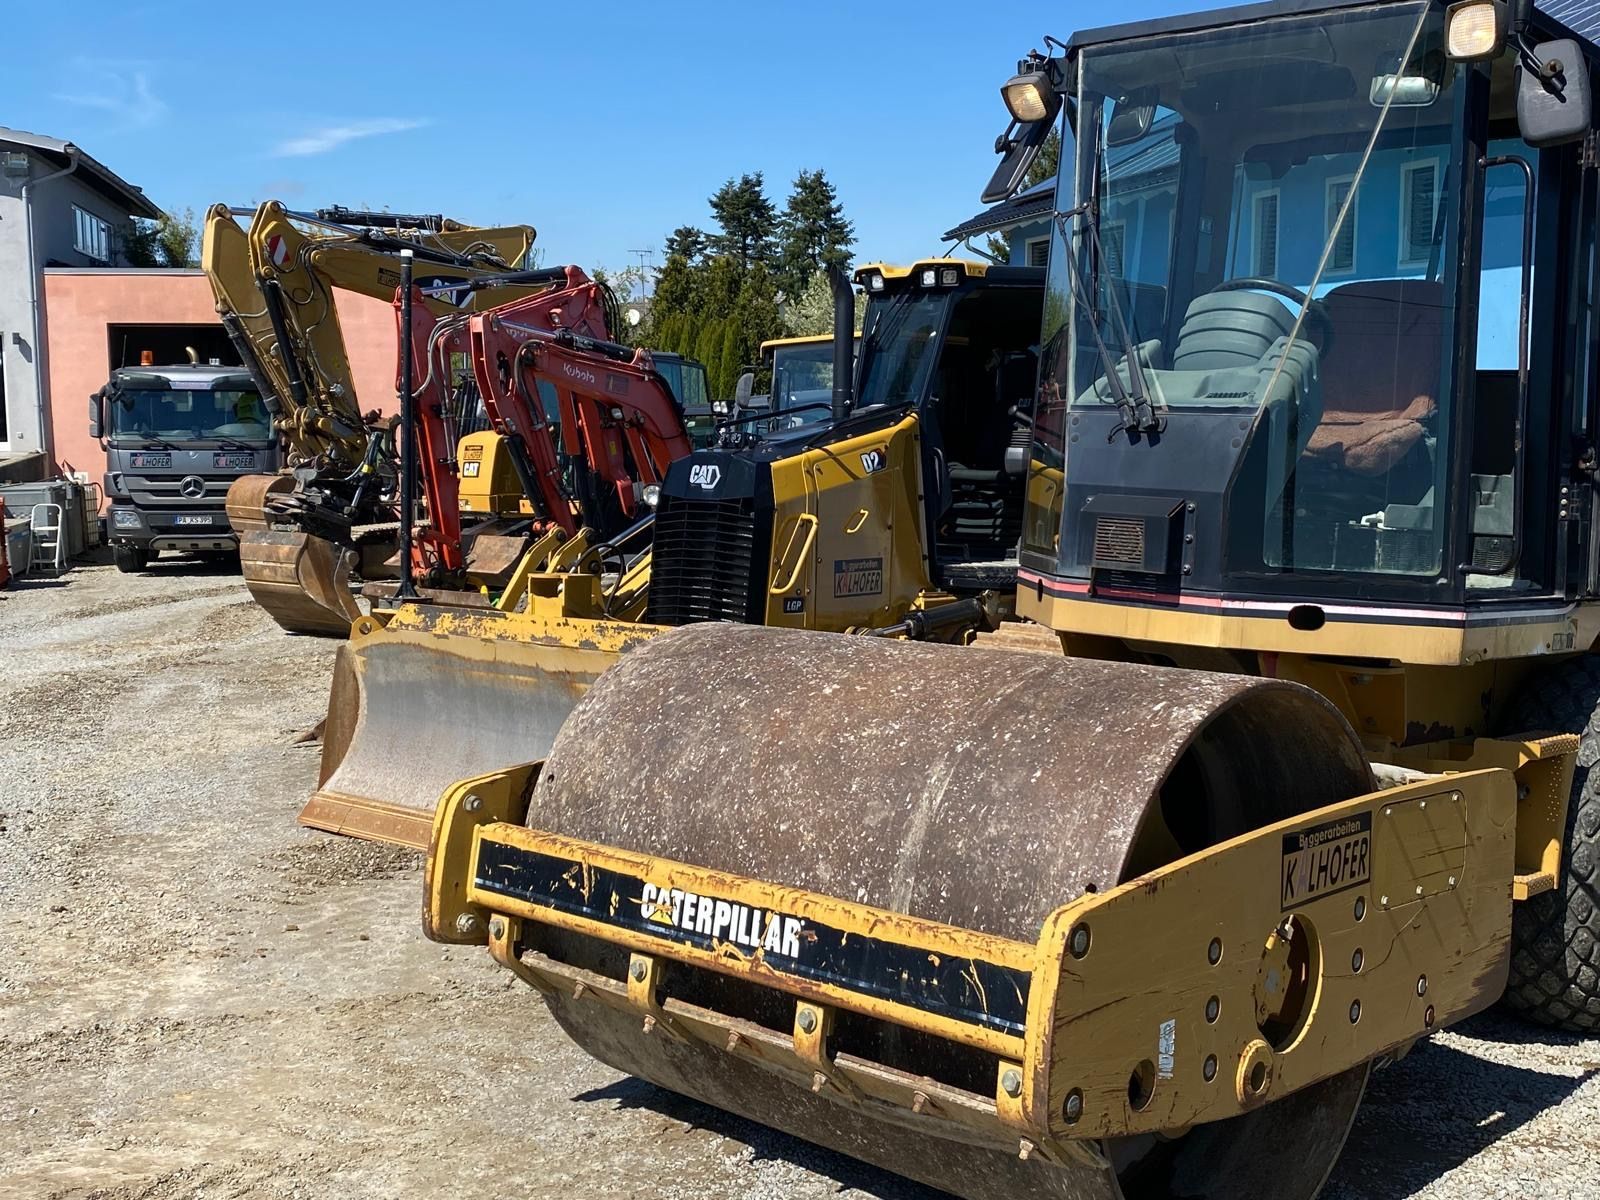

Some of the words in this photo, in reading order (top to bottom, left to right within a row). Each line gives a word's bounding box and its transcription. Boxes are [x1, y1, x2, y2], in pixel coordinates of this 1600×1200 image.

[563, 362, 595, 383] Kubota
[463, 462, 479, 477] CAT
[861, 453, 880, 474] D2
[689, 464, 715, 485] CAT
[786, 600, 802, 611] LGP
[640, 882, 802, 958] CATERPILLAR
